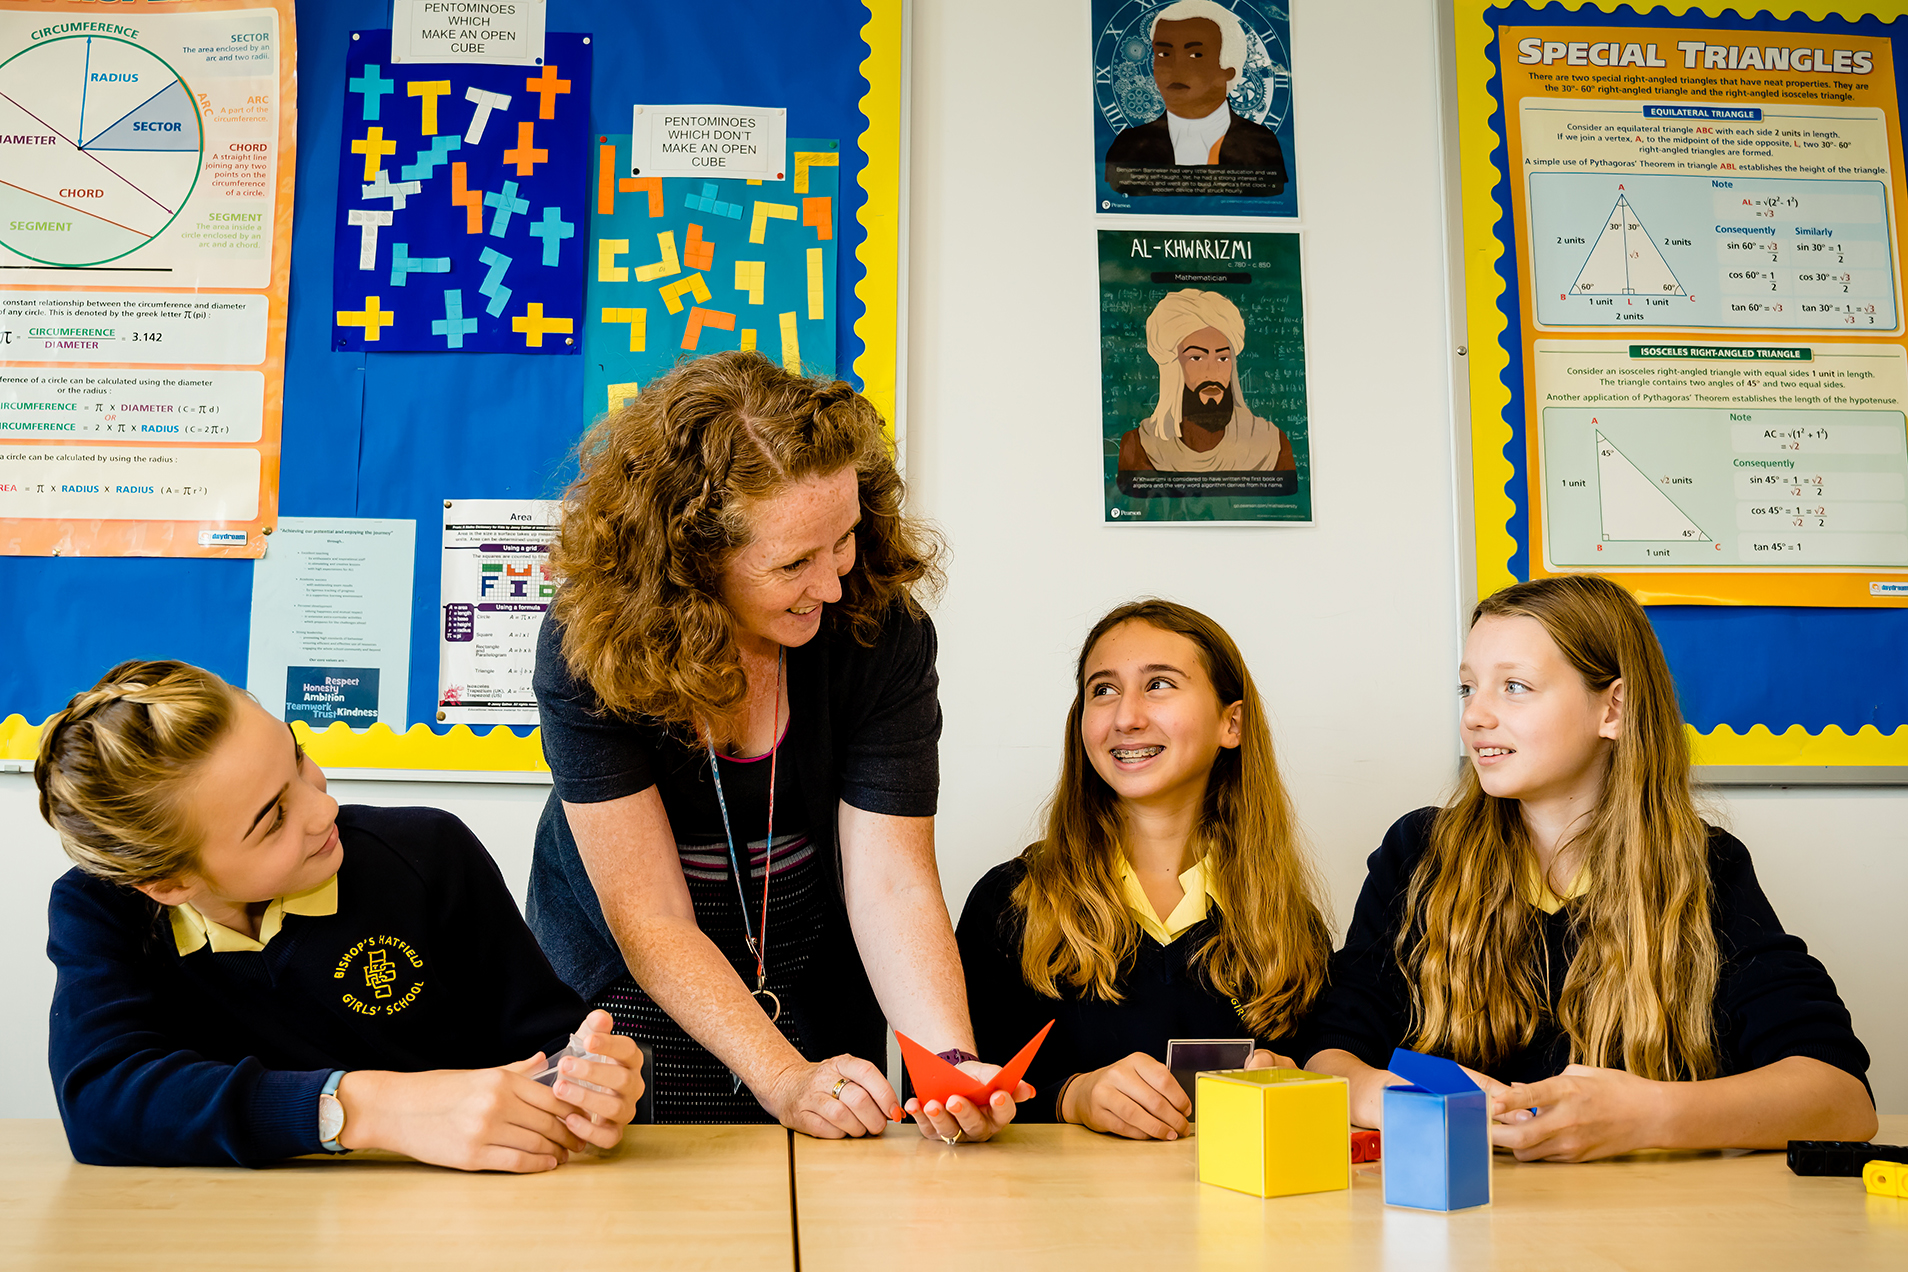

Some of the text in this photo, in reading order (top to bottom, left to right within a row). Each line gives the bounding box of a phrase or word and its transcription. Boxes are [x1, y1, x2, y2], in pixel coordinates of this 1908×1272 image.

[425, 3, 515, 14] PENTOMINOES
[448, 16, 490, 26] WHICH
[31, 22, 140, 40] CIRCUMFERENCE
[422, 30, 515, 40] MAKE AN OPEN
[231, 33, 269, 42] SECTOR
[250, 44, 258, 52] by
[451, 43, 484, 53] CUBE
[1517, 37, 1874, 75] SPECIAL TRIANGLES
[91, 73, 138, 82] RADIUS
[1528, 72, 1553, 81] There
[1592, 75, 1621, 83] special
[1624, 75, 1677, 85] right-angled
[1680, 77, 1717, 86] triangles
[1740, 78, 1761, 86] have
[1786, 80, 1831, 88] properties.
[1833, 81, 1853, 91] They
[197, 93, 214, 117] ARC
[247, 96, 268, 104] ARC
[1651, 108, 1753, 118] EQUILATERAL TRIANGLE
[132, 121, 181, 132] SECTOR
[665, 117, 755, 128] PENTOMINOES
[668, 130, 751, 140] WHICH DON'T
[1567, 123, 1602, 131] Consider
[1617, 125, 1660, 133] equilateral
[1662, 126, 1693, 135] triangle
[1813, 131, 1840, 140] length.
[229, 144, 267, 152] CHORD
[663, 143, 756, 154] MAKE AN OPEN
[221, 154, 250, 162] straight
[692, 157, 725, 167] CUBE
[205, 162, 232, 170] joining
[1711, 180, 1733, 189] Note
[59, 189, 104, 198] CHORD
[209, 213, 262, 221] SEGMENT
[10, 222, 72, 231] SEGMENT
[1715, 225, 1776, 236] Consequently
[1795, 227, 1832, 237] Similarly
[1131, 238, 1252, 260] AL-KHWARIZMI
[29, 328, 114, 336] CIRCUMFERENCE
[133, 332, 162, 342] 3.142
[45, 341, 98, 349] DIAMETER
[1640, 348, 1800, 358] ISOSCELES RIGHT-ANGLED TRIANGLE
[1658, 368, 1707, 377] right-angled
[1710, 369, 1741, 378] triangle
[1765, 370, 1787, 378] equal
[1819, 370, 1835, 378] unit
[1847, 371, 1874, 379] length.
[1547, 393, 1580, 401] Another
[1583, 394, 1629, 402] application
[1632, 393, 1640, 401] of
[1695, 394, 1729, 402] Theorem
[1795, 396, 1820, 404] length
[1849, 396, 1898, 405] hypotenuse.
[1729, 413, 1752, 422] Note
[1733, 458, 1795, 469] Consequently
[510, 513, 531, 521] Area
[325, 677, 360, 687] Respect
[303, 684, 339, 694] Honesty
[304, 693, 345, 702] Ambition
[286, 702, 332, 711] Teamwork
[313, 710, 337, 718] Trust
[337, 708, 378, 717] Kindness
[378, 935, 423, 968] HATFIELD
[386, 981, 424, 1015] SCHOOL
